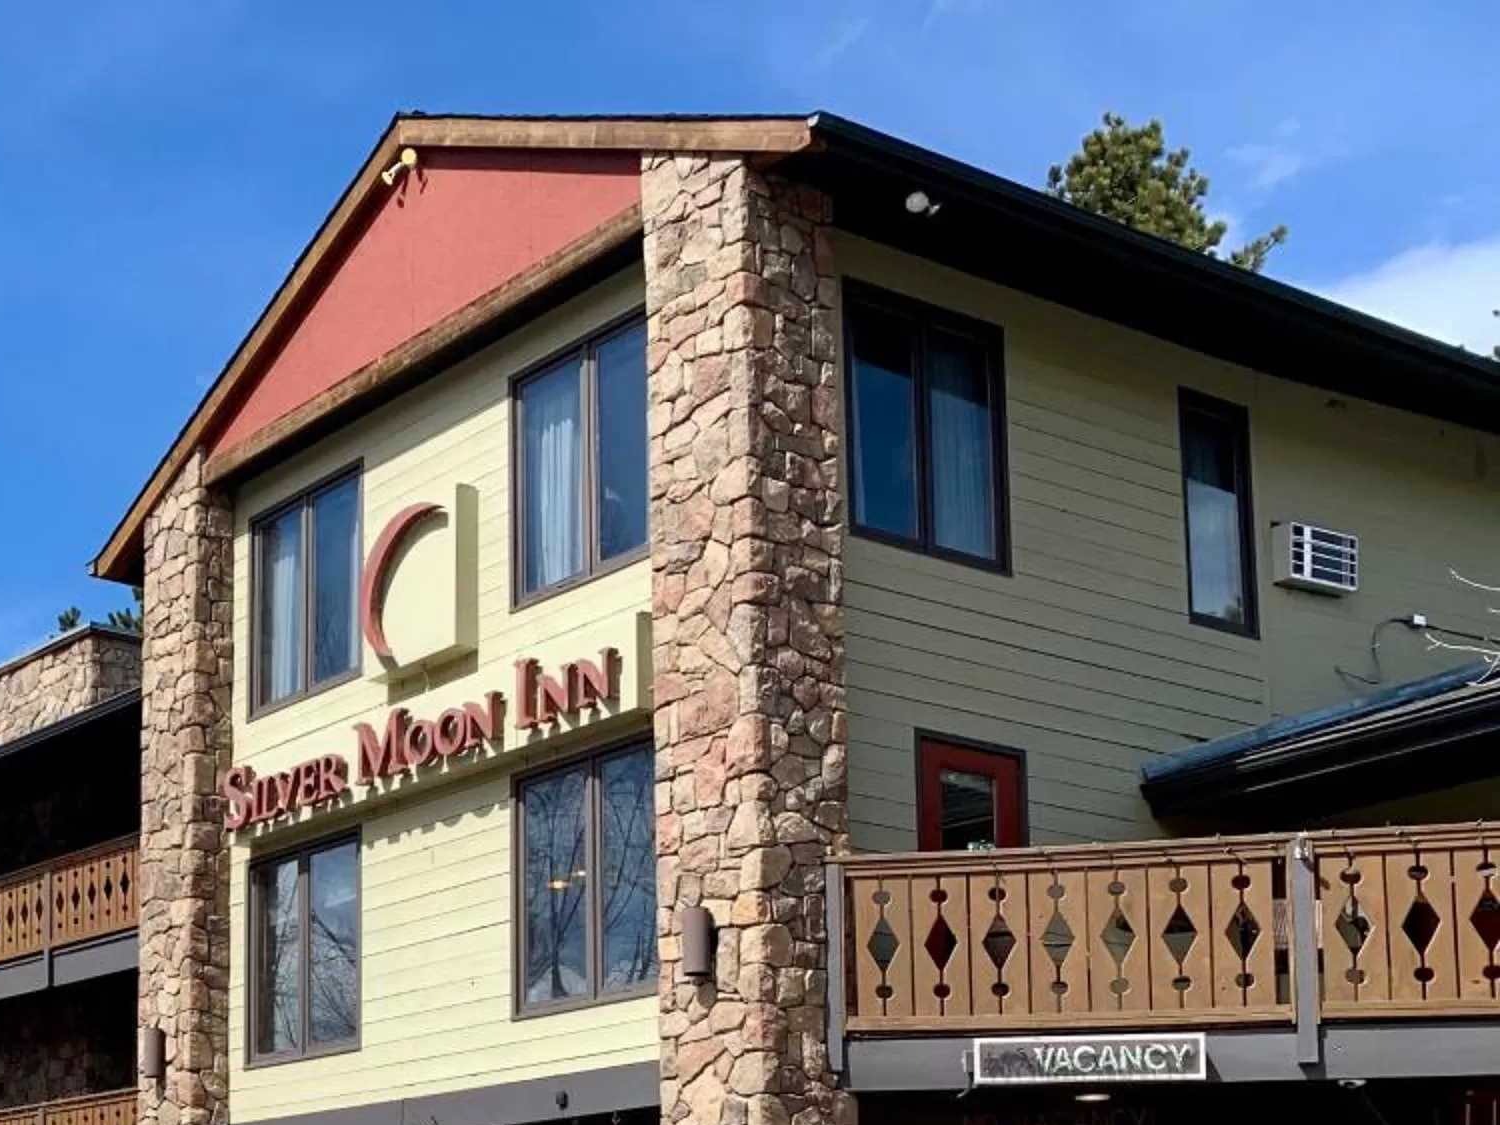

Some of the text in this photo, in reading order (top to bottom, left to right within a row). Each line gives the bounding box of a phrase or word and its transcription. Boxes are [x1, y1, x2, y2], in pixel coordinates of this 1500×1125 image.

[222, 647, 622, 831] SILVER MOON INN
[1033, 1043, 1194, 1073] VACANCY
